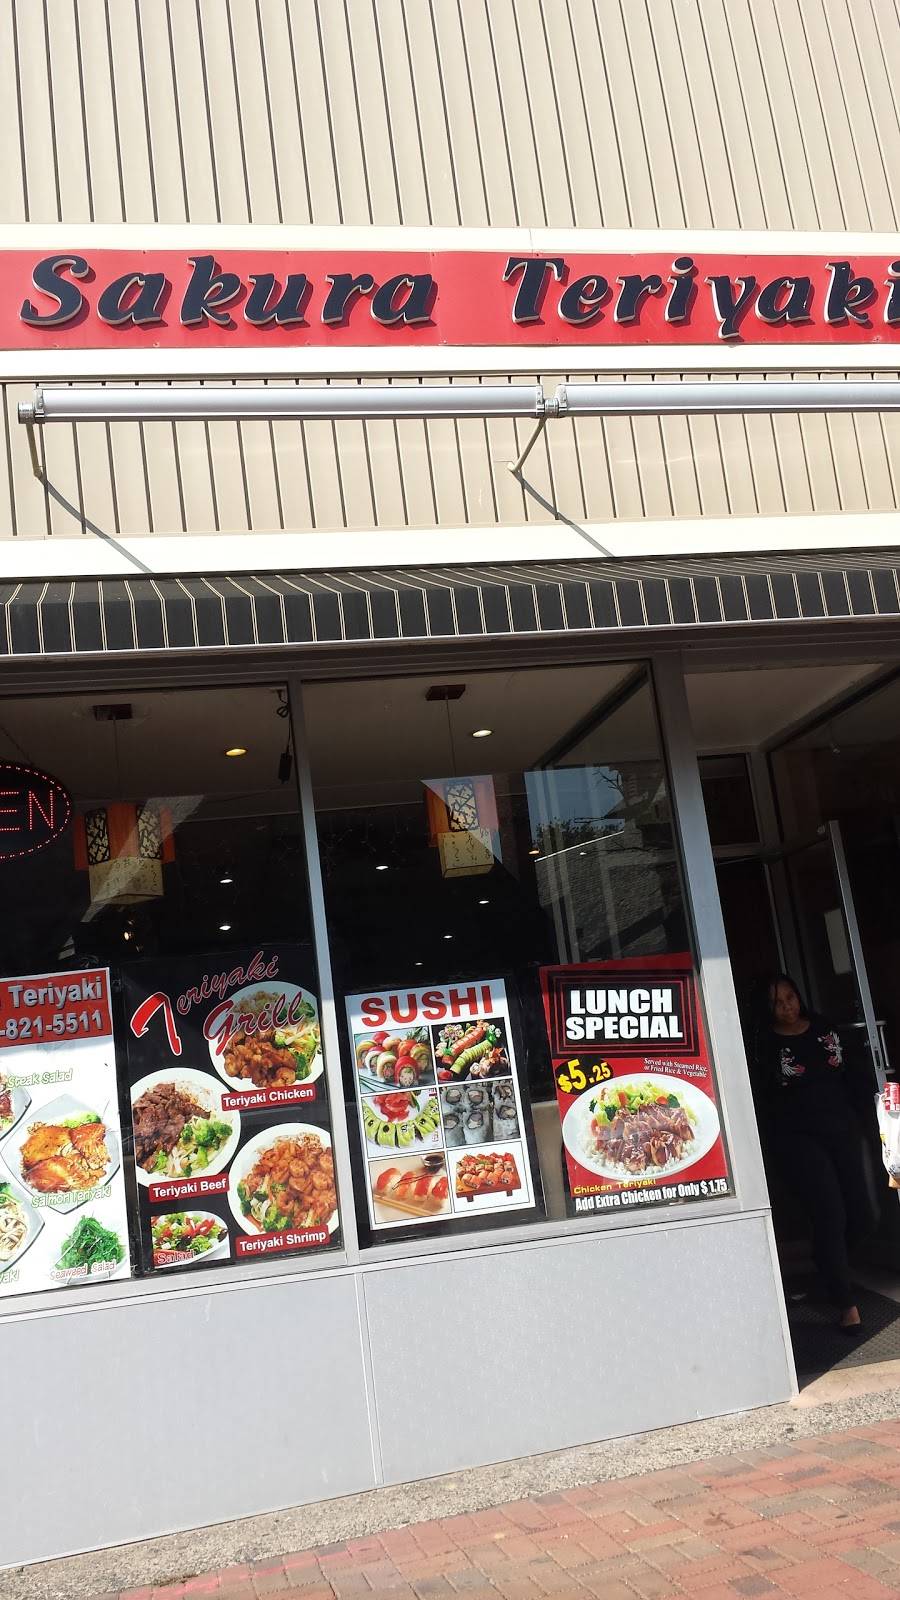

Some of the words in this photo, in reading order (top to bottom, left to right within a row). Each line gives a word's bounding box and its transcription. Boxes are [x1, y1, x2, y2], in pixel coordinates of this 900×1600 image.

[19, 255, 434, 326] Sakura
[8, 976, 102, 1009] Teriyaki
[129, 950, 279, 1056] Teriyaki
[570, 989, 673, 1015] LUNCH
[361, 985, 494, 1027] SUSHI
[203, 991, 304, 1056] Grill
[566, 1016, 683, 1040] SPECIAL
[644, 1058, 661, 1066] Served
[674, 1062, 695, 1070] Steamed
[650, 1065, 664, 1073] Fried
[664, 1066, 676, 1074] Rice
[6, 1073, 40, 1089] Steak
[42, 1068, 74, 1085] Salad
[557, 1058, 611, 1094] $5.25
[223, 1093, 266, 1108] Teriyaki
[269, 1088, 313, 1103] Chicken
[31, 1192, 72, 1208] Salmon
[73, 1185, 112, 1204] Teriyaki
[153, 1183, 197, 1199] Teriyaki
[200, 1178, 227, 1191] Beef
[573, 1184, 612, 1195] Chicken
[617, 1178, 656, 1189] Teriyaki
[575, 1196, 595, 1211] Add
[595, 1194, 621, 1209] Extra
[621, 1190, 660, 1205] Chicken
[661, 1188, 677, 1200] for
[678, 1183, 700, 1198] Only
[240, 1237, 284, 1253] Teriyaki
[286, 1231, 327, 1245] Shrimp
[156, 1250, 195, 1264] Salad
[50, 1263, 88, 1280] Seaweed
[91, 1259, 117, 1274] Salad
